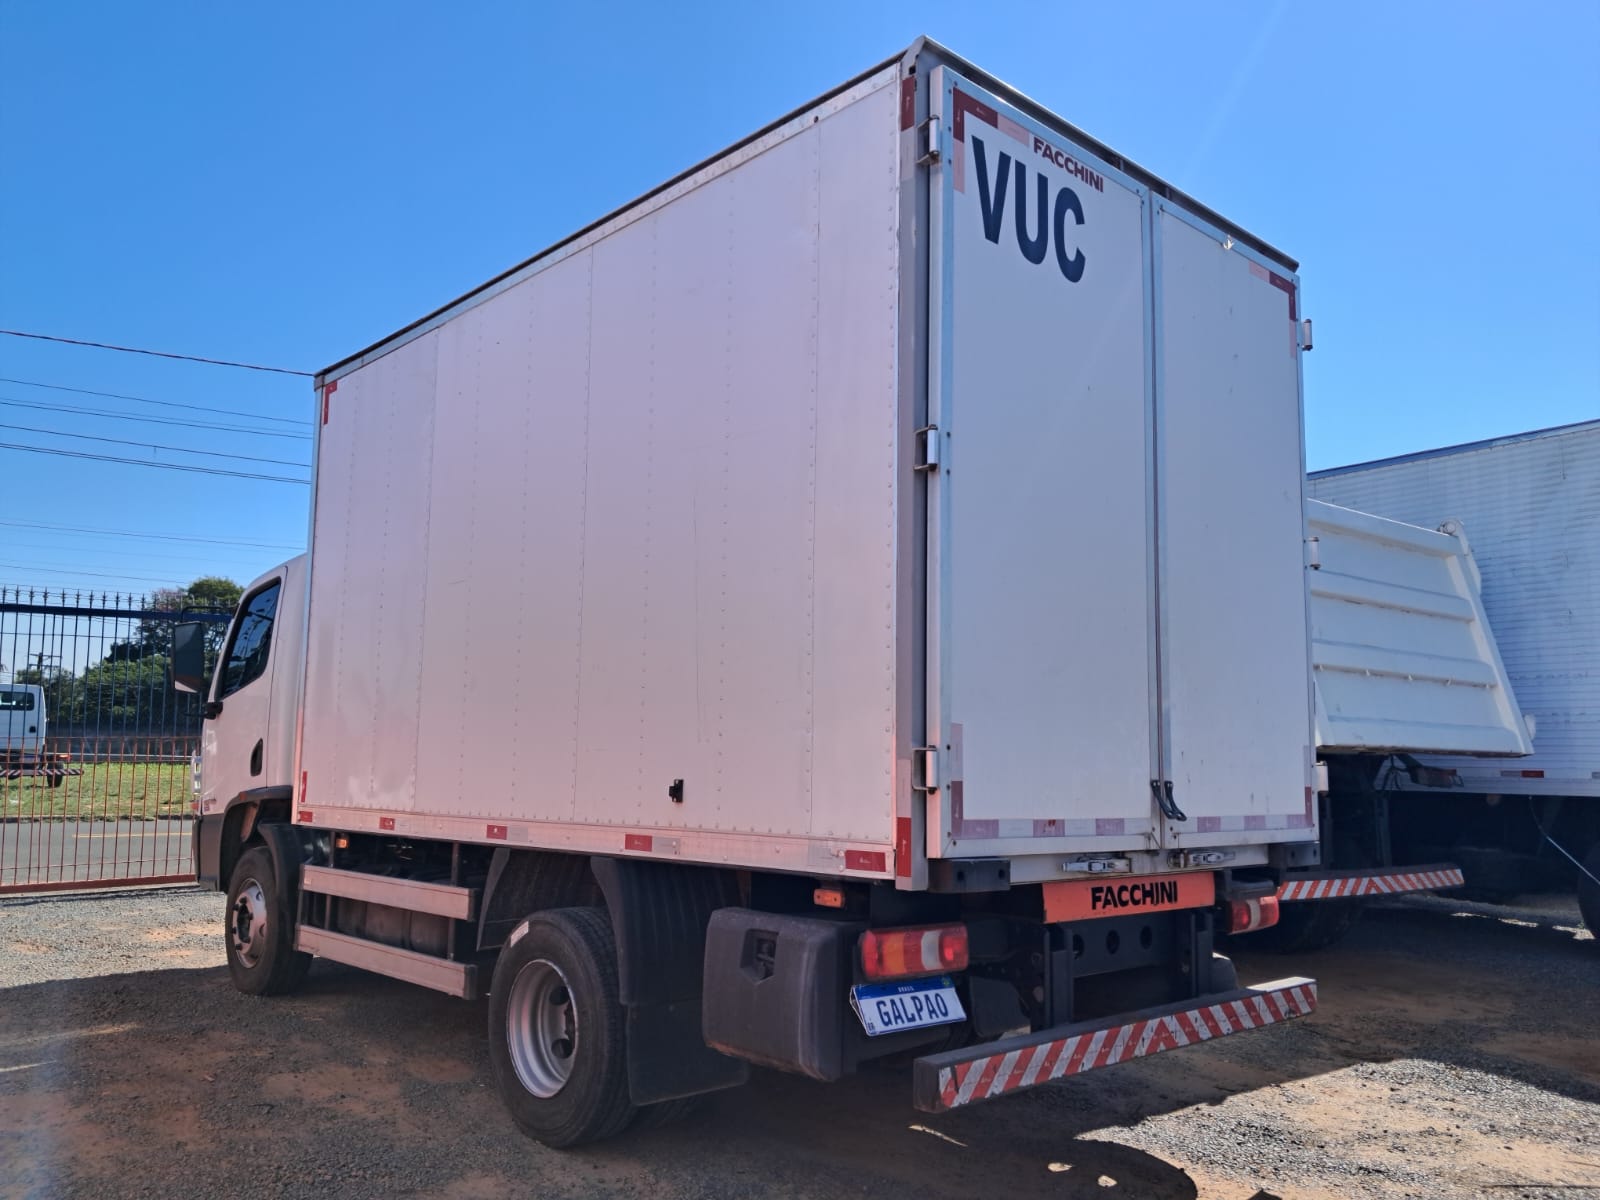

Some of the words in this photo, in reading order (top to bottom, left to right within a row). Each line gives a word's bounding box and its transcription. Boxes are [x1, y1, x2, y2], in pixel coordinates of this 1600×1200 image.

[1033, 136, 1104, 193] FACCHINI
[971, 134, 1086, 283] VUC
[1091, 881, 1178, 910] FACCHINI
[876, 993, 949, 1027] GALPAO
